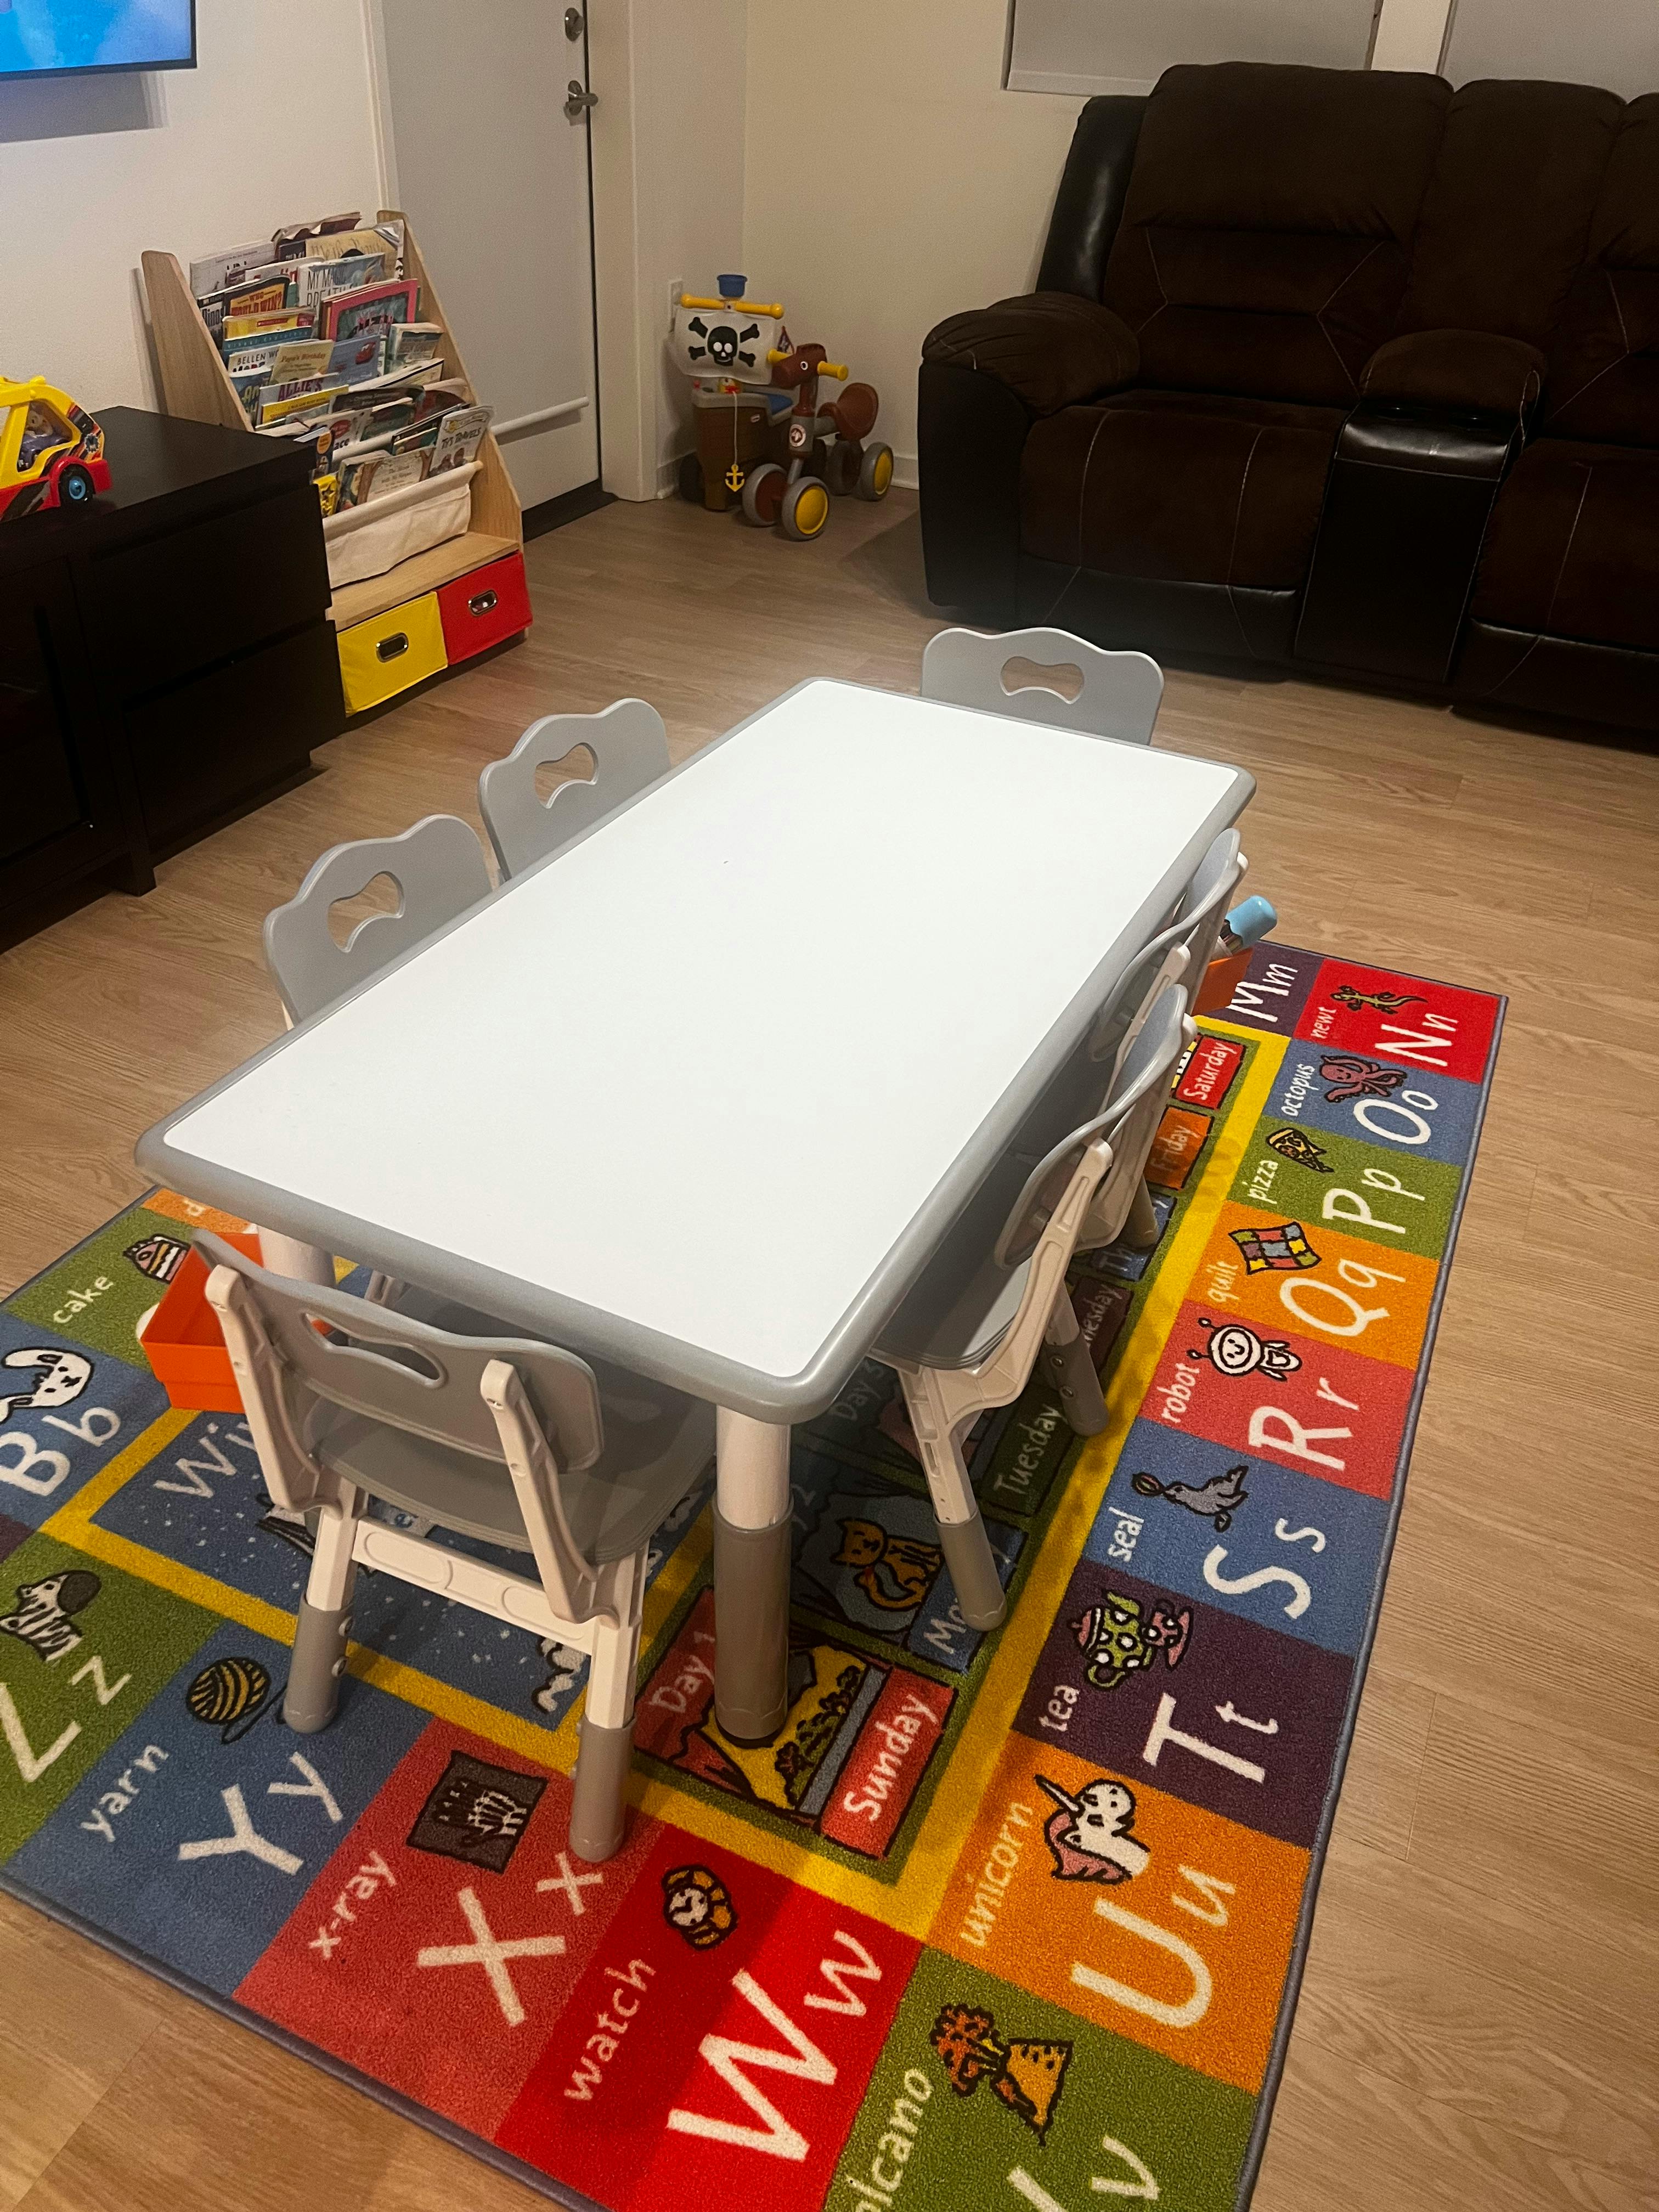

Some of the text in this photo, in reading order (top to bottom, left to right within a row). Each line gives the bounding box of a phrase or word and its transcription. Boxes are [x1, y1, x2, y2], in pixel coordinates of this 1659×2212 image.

[307, 270, 320, 291] MY
[1310, 1007, 1337, 1041] newt
[1183, 1042, 1238, 1101] Saturday
[1280, 1062, 1316, 1117] octopus
[1152, 1124, 1201, 1172] Friday
[1247, 1159, 1279, 1204] pizza
[53, 1273, 114, 1324] cake
[1207, 1261, 1239, 1304] quilt
[1161, 1362, 1200, 1425] robot
[994, 1403, 1069, 1500] Tuesday
[1108, 1506, 1145, 1562] seal
[648, 1654, 715, 1714] Day
[1039, 1684, 1080, 1732] tea
[843, 1694, 940, 1822] Sunday
[80, 1745, 169, 1843] yarn
[960, 1801, 1034, 1949] unicorn
[308, 1850, 397, 1961] x-ray
[563, 1958, 657, 2102] watch
